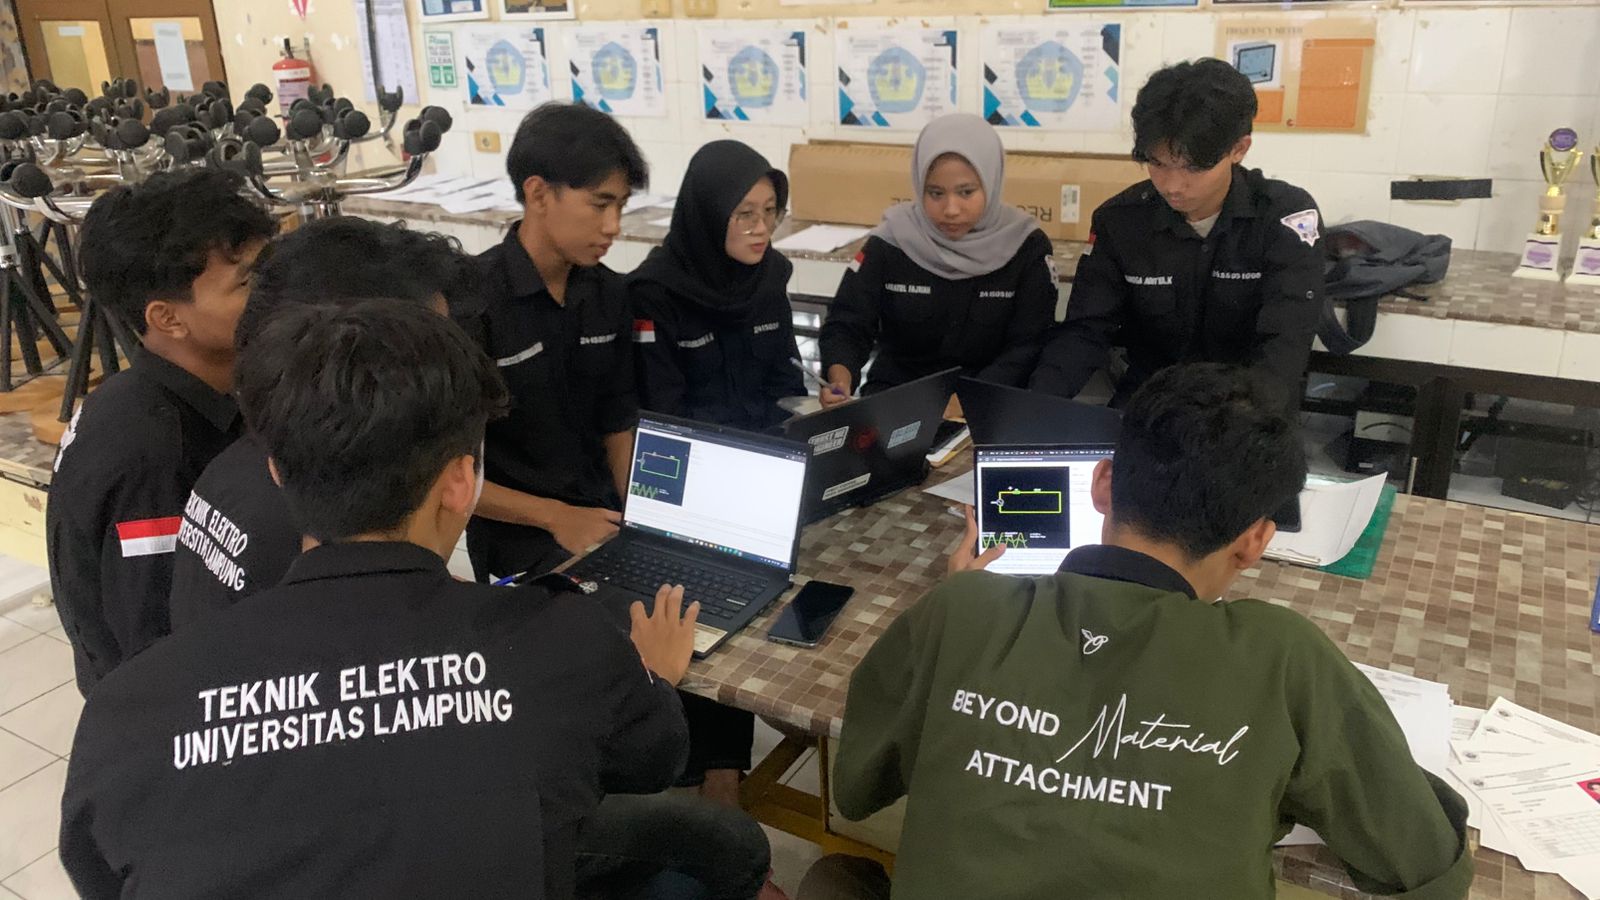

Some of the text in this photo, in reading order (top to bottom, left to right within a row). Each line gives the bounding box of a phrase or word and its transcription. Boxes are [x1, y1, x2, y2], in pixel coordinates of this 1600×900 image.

[205, 541, 246, 591] LAMPUNG
[207, 509, 248, 557] ELEKTRO
[198, 652, 487, 722] TEKNIK ELEKTRO
[173, 689, 513, 770] UNIVERSITAS LAMPUNG
[952, 689, 1250, 766] BEYOND Material
[965, 749, 1172, 811] ATTACHMENT
